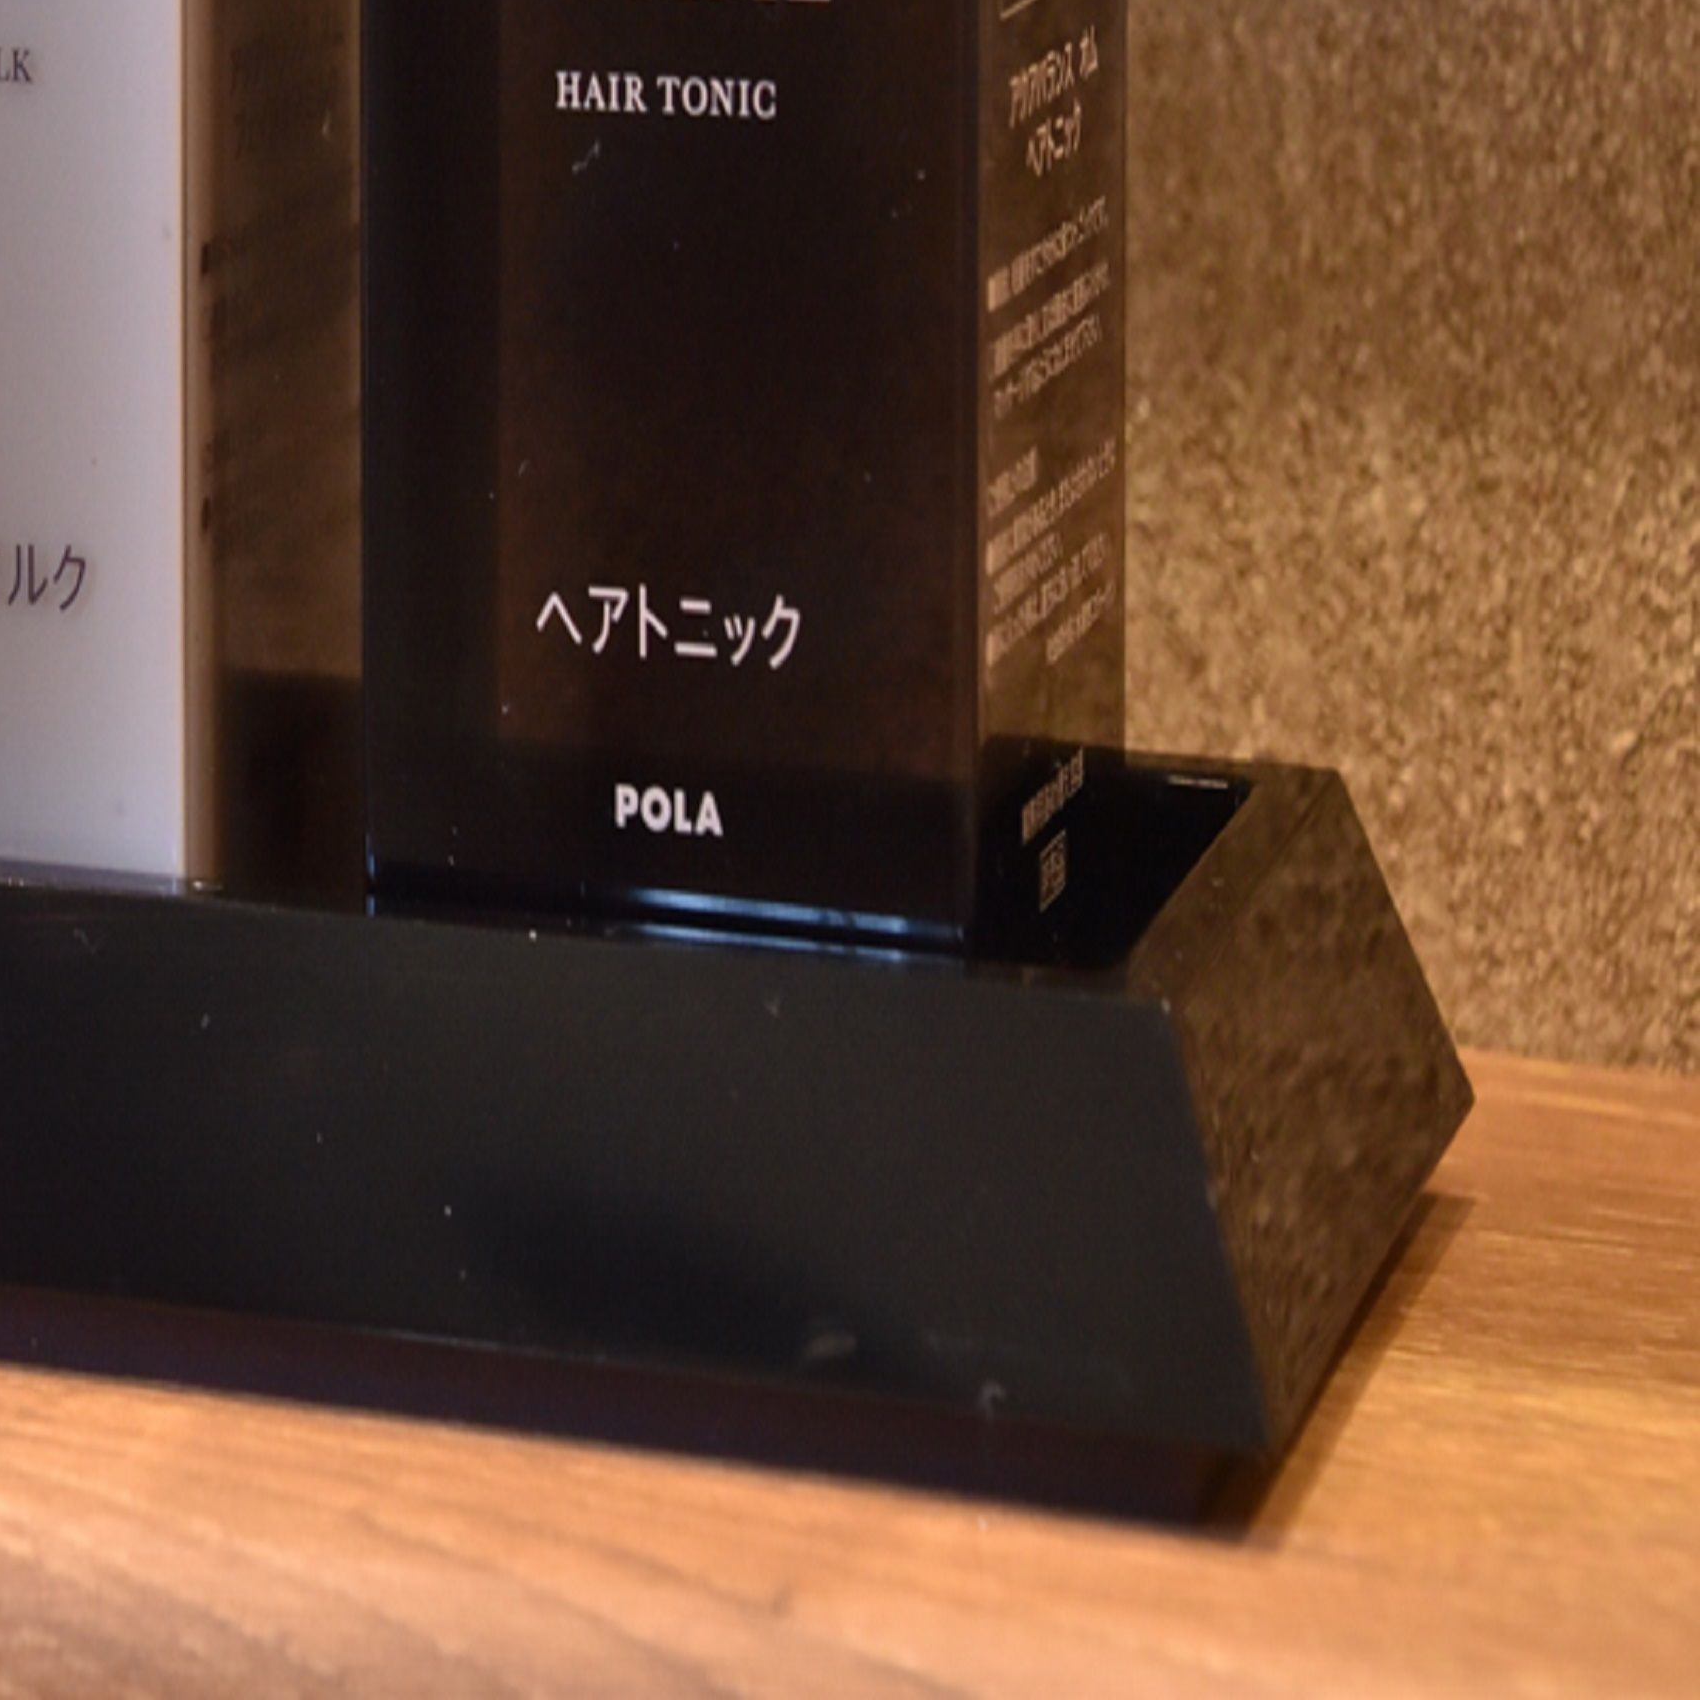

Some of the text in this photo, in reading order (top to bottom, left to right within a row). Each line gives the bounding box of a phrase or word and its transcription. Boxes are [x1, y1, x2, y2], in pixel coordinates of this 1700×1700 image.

[556, 70, 778, 120] HAIR TONIC
[536, 583, 801, 670] ヘアトニック
[614, 782, 724, 836] POLA
